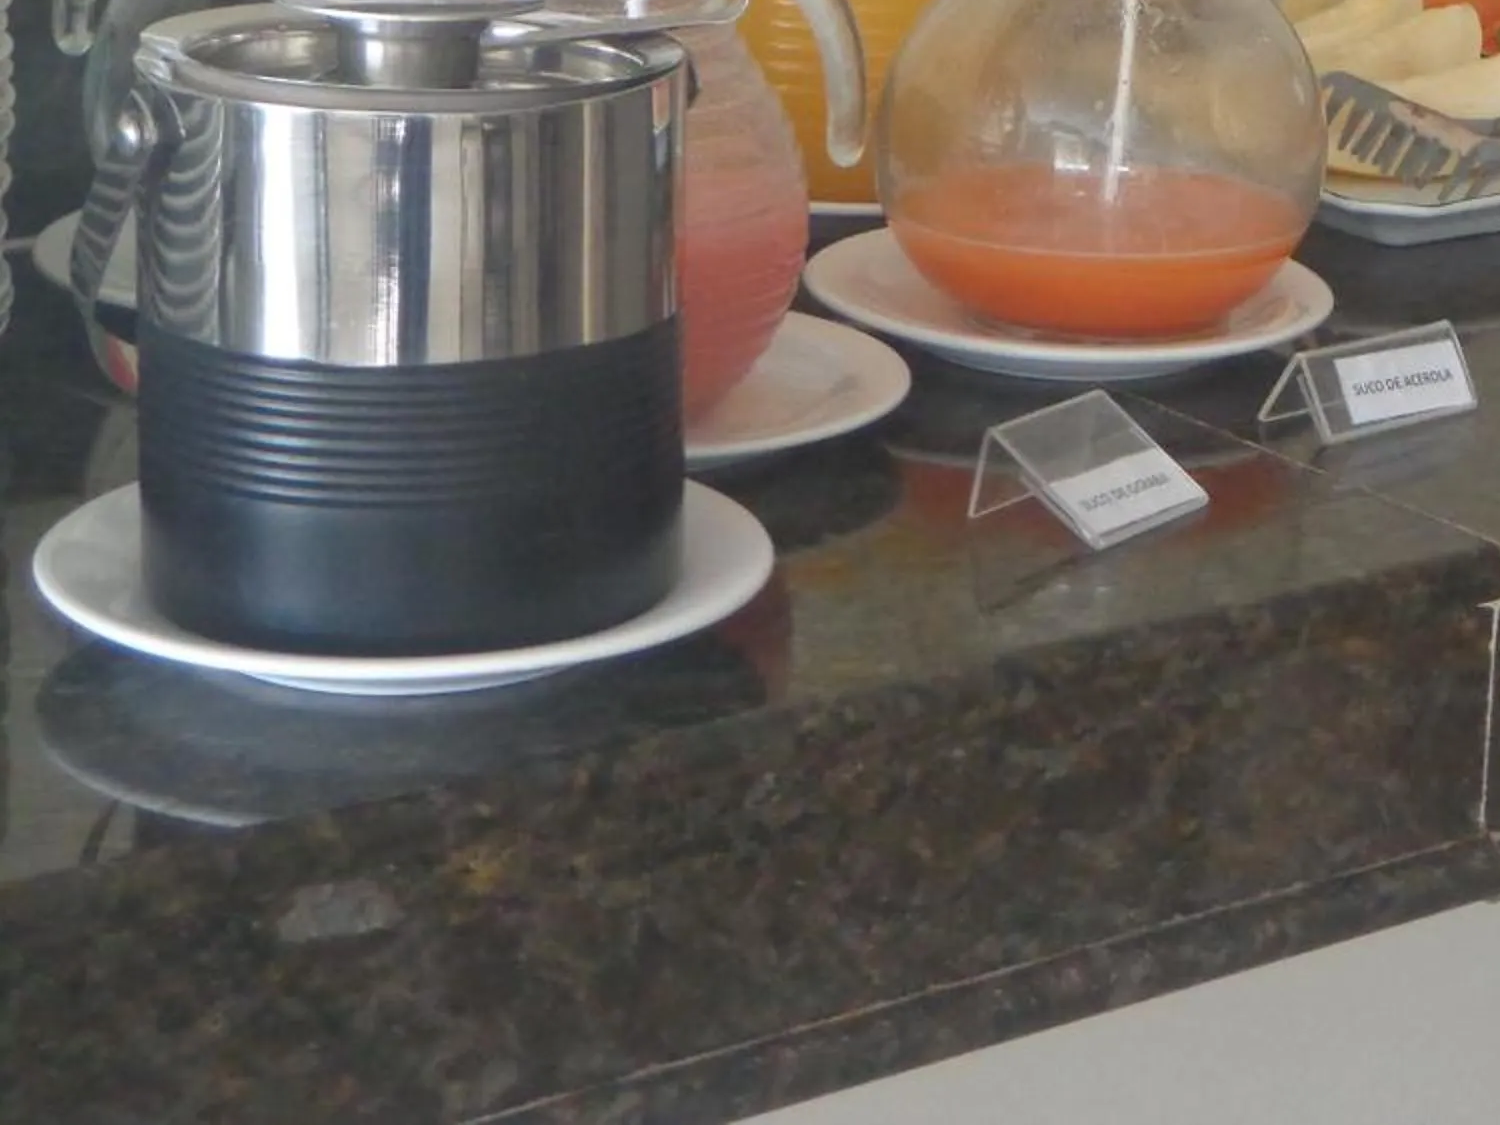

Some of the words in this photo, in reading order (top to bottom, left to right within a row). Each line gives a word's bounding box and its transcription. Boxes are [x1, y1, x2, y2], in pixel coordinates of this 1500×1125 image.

[1352, 379, 1385, 396] SUCO
[1386, 376, 1403, 392] DE
[1403, 368, 1454, 387] ACEROLA
